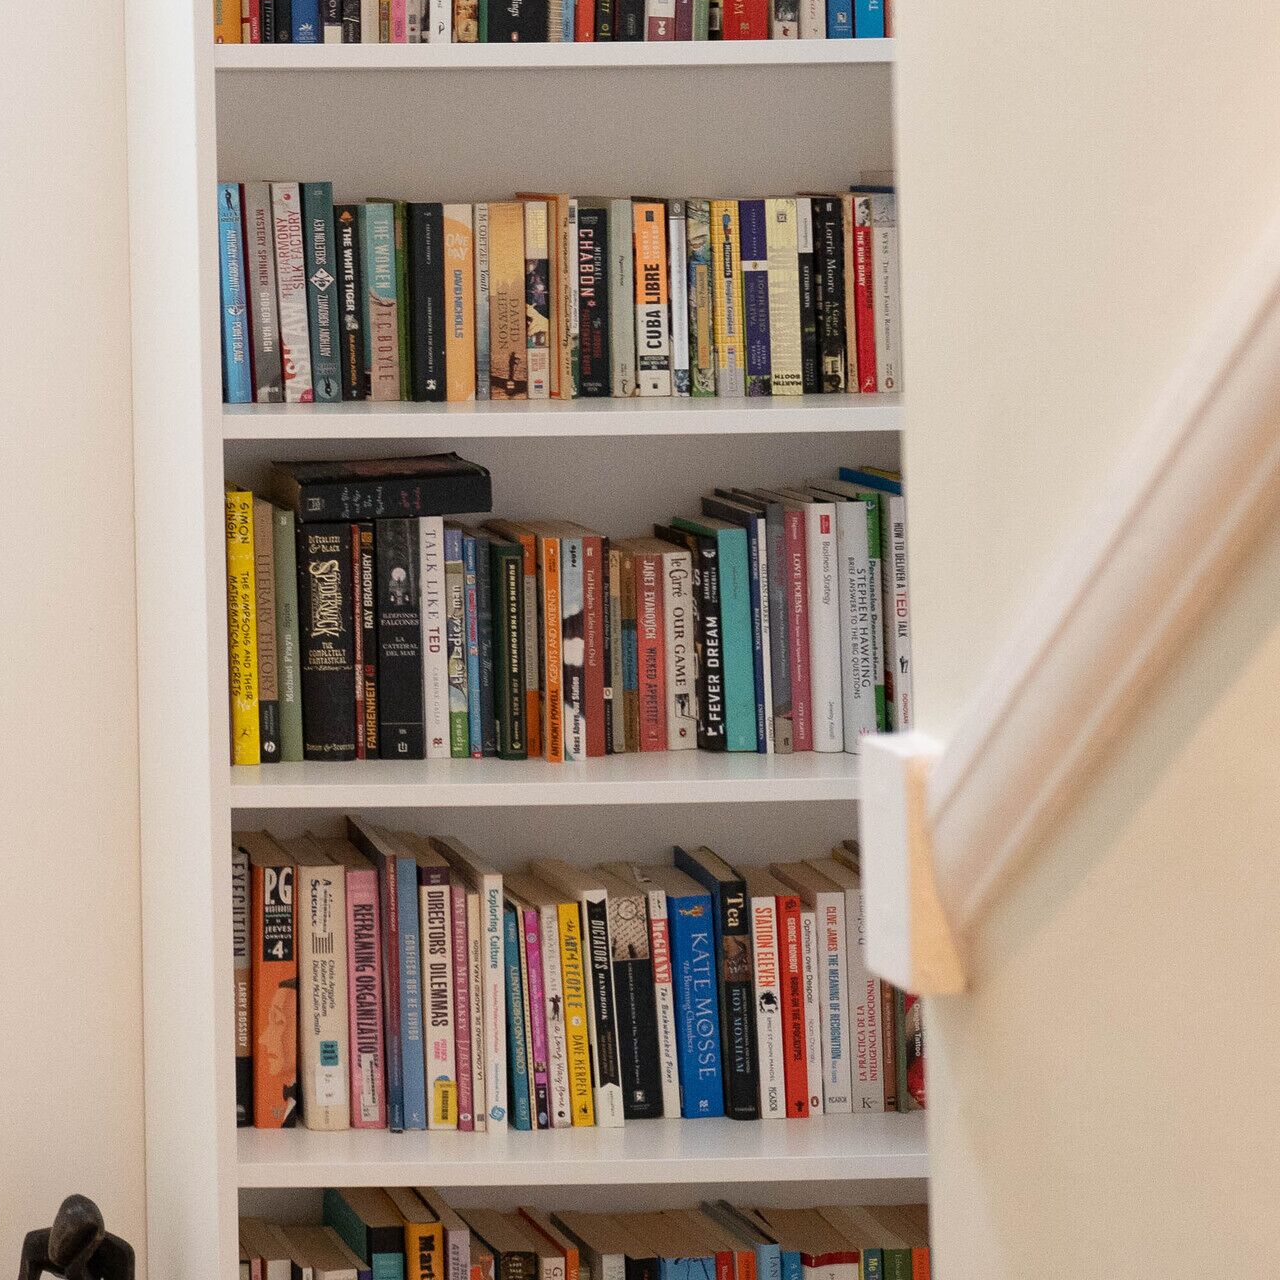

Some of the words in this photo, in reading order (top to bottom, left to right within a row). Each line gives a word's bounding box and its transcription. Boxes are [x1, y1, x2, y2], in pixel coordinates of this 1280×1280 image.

[256, 209, 265, 247] MYSTERY
[342, 227, 352, 248] THE
[825, 222, 835, 254] Lorrie
[258, 250, 267, 286] SPINNER
[343, 250, 353, 281] WHITE
[580, 229, 593, 297] CHABON
[827, 259, 836, 293] Moore
[345, 283, 354, 311] TIGER
[644, 264, 660, 304] LIBRE
[261, 292, 270, 324] GIDEON
[497, 291, 507, 350] HEWSON
[511, 298, 519, 342] DAVID
[263, 326, 272, 352] HAIGH
[646, 310, 661, 349] CUBA
[227, 503, 237, 539] SINGH
[239, 502, 249, 544] SIMON
[894, 523, 904, 540] HOW
[425, 530, 437, 572] TALK
[671, 558, 685, 567] le
[822, 541, 831, 572] Business
[895, 542, 905, 551] TO
[363, 553, 372, 604] BRADBURY
[669, 568, 687, 598] Carré
[895, 553, 906, 581] DELIVER
[257, 554, 272, 624] LITERARY
[309, 559, 346, 637] SPIDERWICK
[426, 580, 438, 620] LIKE
[821, 575, 832, 605] Strategy
[849, 577, 857, 610] ANSWERS
[857, 568, 867, 621] STEPHEN
[896, 592, 907, 617] TED
[230, 575, 239, 649] MATHEMATICAL
[241, 593, 251, 645] SIMPSONS
[364, 606, 373, 628] RAY
[673, 606, 685, 640] OUR
[850, 612, 857, 621] TO
[898, 621, 908, 637] TALK
[429, 627, 440, 653] TED
[705, 616, 719, 666] DREAM
[860, 627, 871, 687] HAWKING
[232, 653, 241, 696] SECRETS
[244, 649, 252, 669] AND
[261, 633, 275, 693] THEORY
[674, 645, 686, 687] GAME
[245, 672, 253, 700] THEIR
[852, 658, 861, 699] QUESTIONS
[366, 681, 376, 749] FAHRENHEIT
[708, 675, 721, 721] FEVER
[427, 891, 445, 959] DIRECTORS'
[488, 889, 499, 933] Exploring
[727, 893, 742, 927] Tea
[756, 907, 772, 949] STATION
[826, 906, 837, 925] CLIVE
[354, 903, 376, 971] REFRAMING
[490, 936, 500, 969] Culture
[804, 919, 813, 955] Optimism
[828, 928, 838, 951] JAMES
[591, 919, 607, 970] DICTATOR'S
[599, 973, 608, 1020] HANDBOOK
[691, 933, 710, 992] KATE
[757, 952, 775, 987] ELEVEN
[829, 954, 838, 967] THE
[430, 963, 448, 1027] DILEMMAS
[683, 975, 693, 1009] Burning
[805, 975, 814, 1004] Despair
[829, 969, 839, 1001] MEANING
[356, 975, 377, 1067] ORGANIZATIO
[830, 1003, 840, 1012] OF
[686, 1011, 695, 1053] Chambers
[697, 998, 716, 1080] MOSSE
[830, 1014, 841, 1059] RECOGNITION
